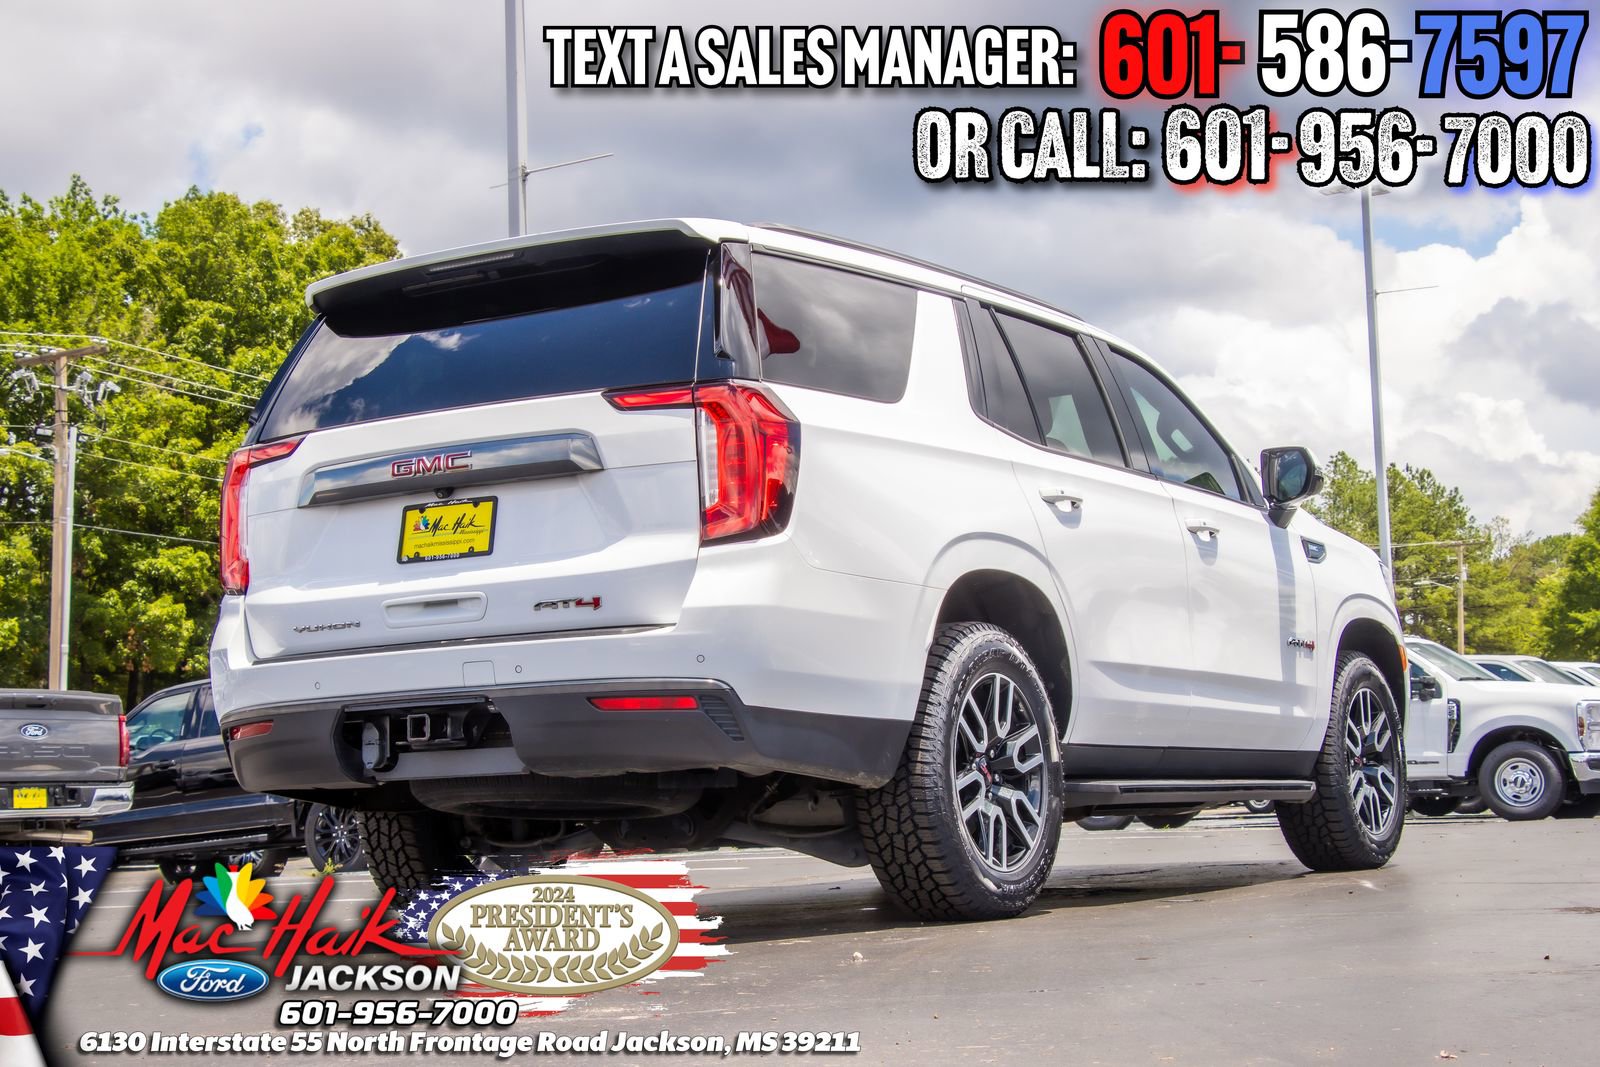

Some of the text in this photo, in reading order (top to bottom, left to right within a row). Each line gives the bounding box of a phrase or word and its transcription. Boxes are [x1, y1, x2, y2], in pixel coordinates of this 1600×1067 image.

[391, 450, 473, 478] GMC
[428, 513, 485, 537] Mac Haik
[533, 596, 602, 612] AT4
[292, 620, 361, 634] YUKON
[25, 726, 44, 737] Ford
